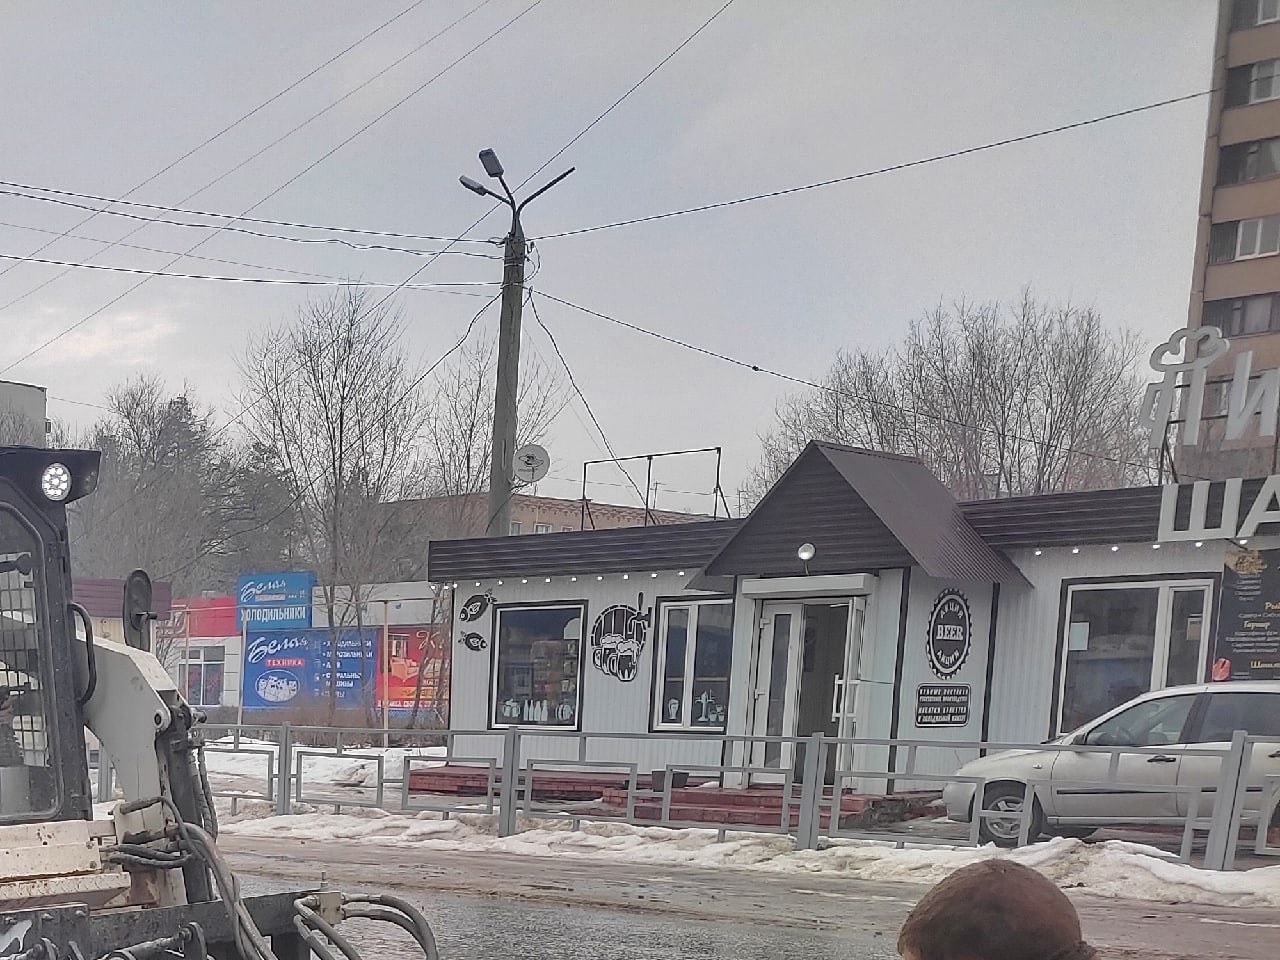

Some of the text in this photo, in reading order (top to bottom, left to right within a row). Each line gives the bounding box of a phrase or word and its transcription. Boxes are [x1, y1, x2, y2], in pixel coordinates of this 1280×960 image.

[936, 624, 963, 641] BEER
[247, 636, 308, 664] Белая
[267, 659, 303, 667] ТЕХНИКА
